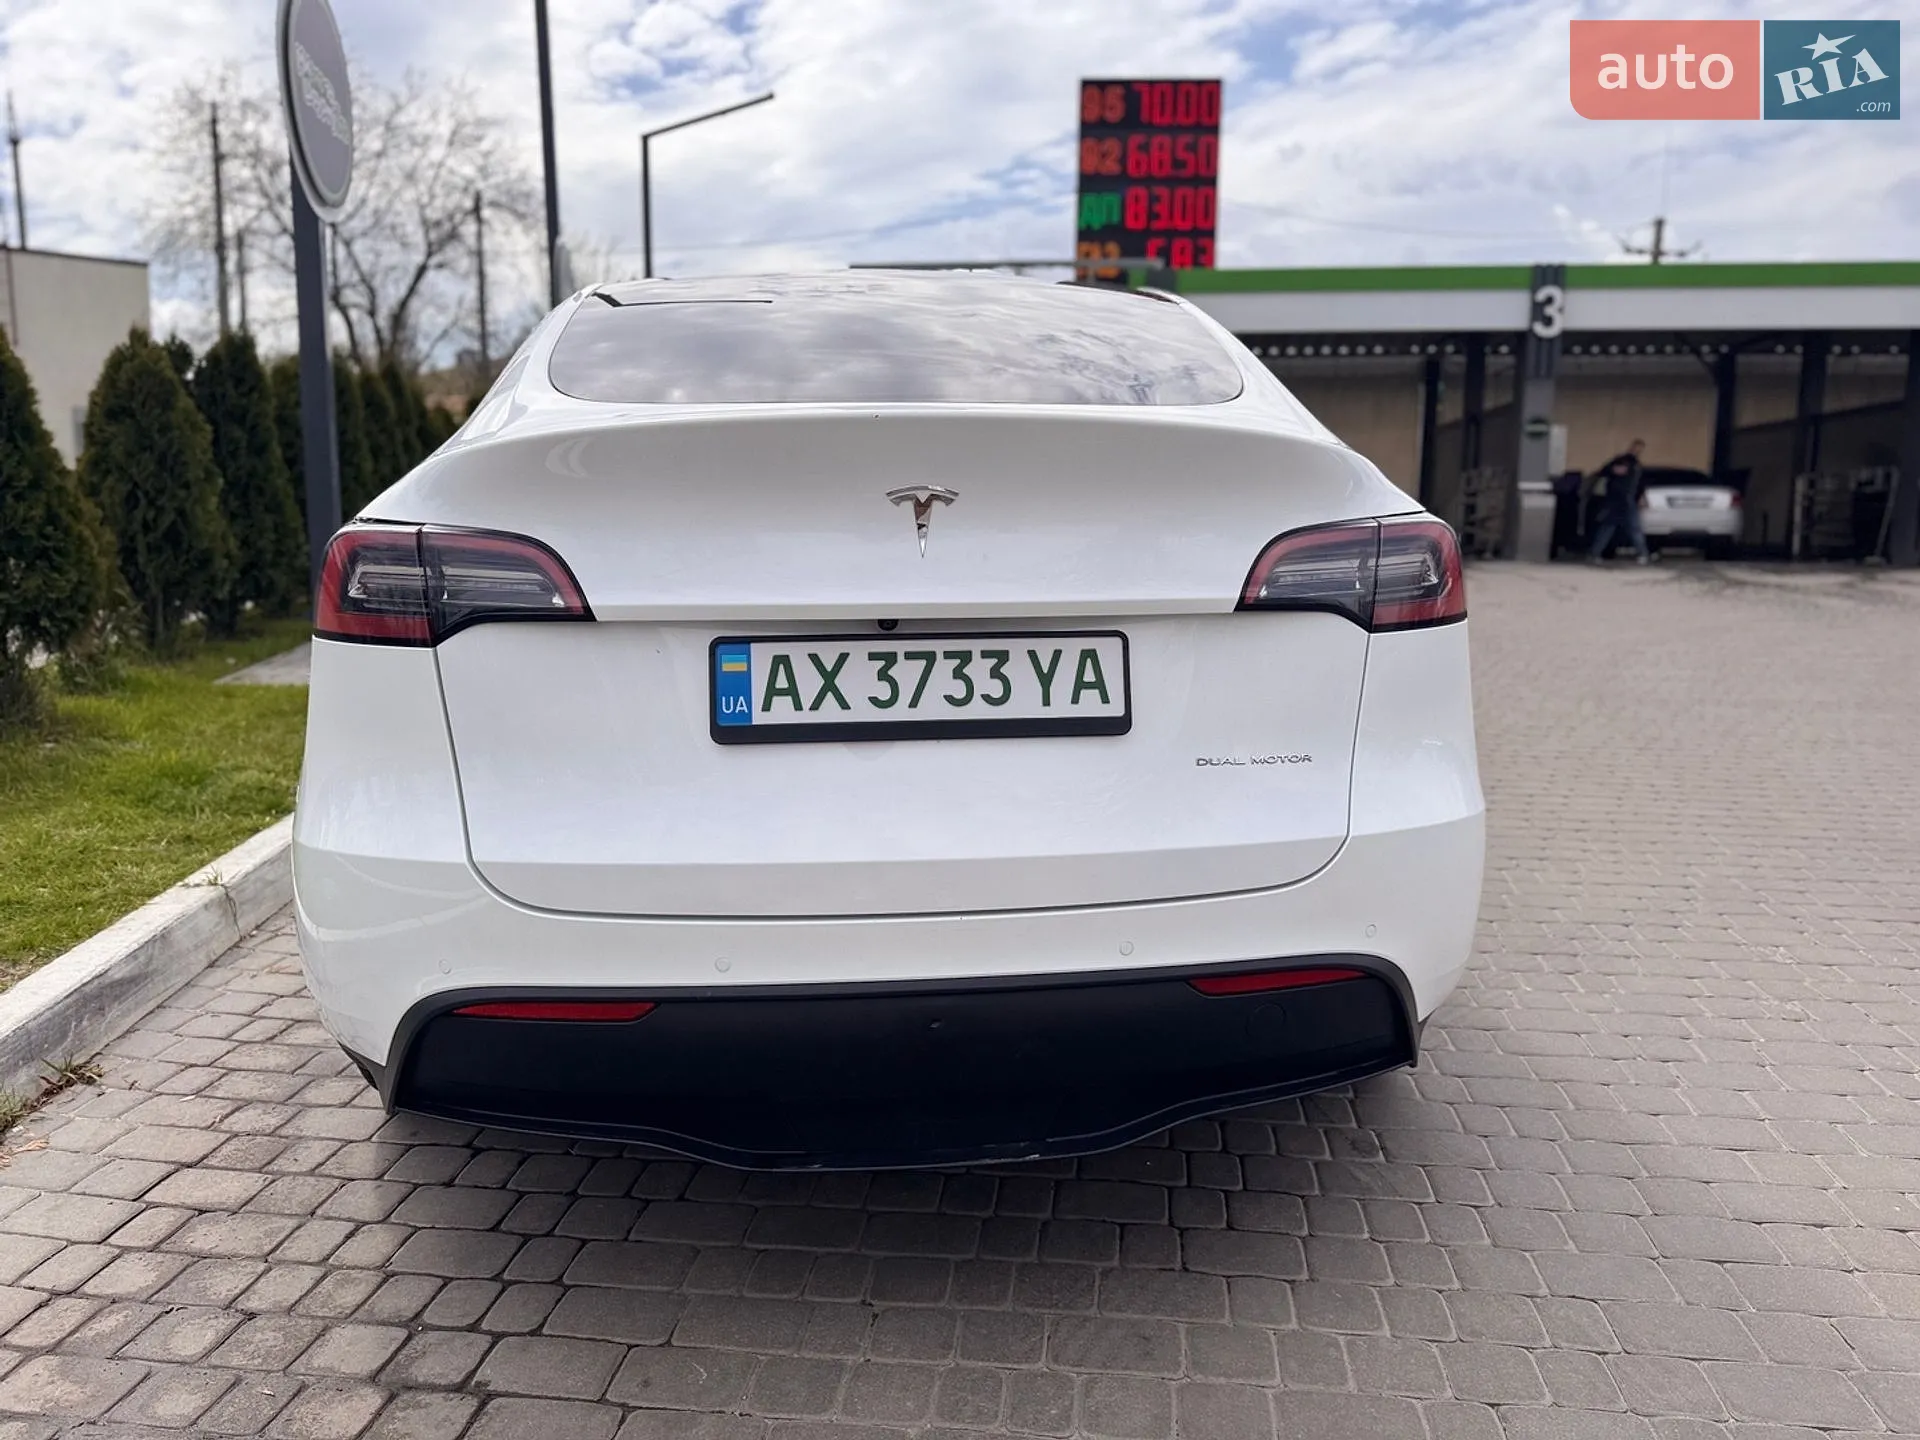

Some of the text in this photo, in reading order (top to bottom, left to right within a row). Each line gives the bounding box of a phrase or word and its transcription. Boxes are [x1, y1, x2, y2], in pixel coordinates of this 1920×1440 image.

[1532, 285, 1565, 339] 3
[761, 648, 1111, 713] AX 3733 YA
[722, 697, 748, 714] UA
[1196, 754, 1313, 767] DUAL MOTOR
